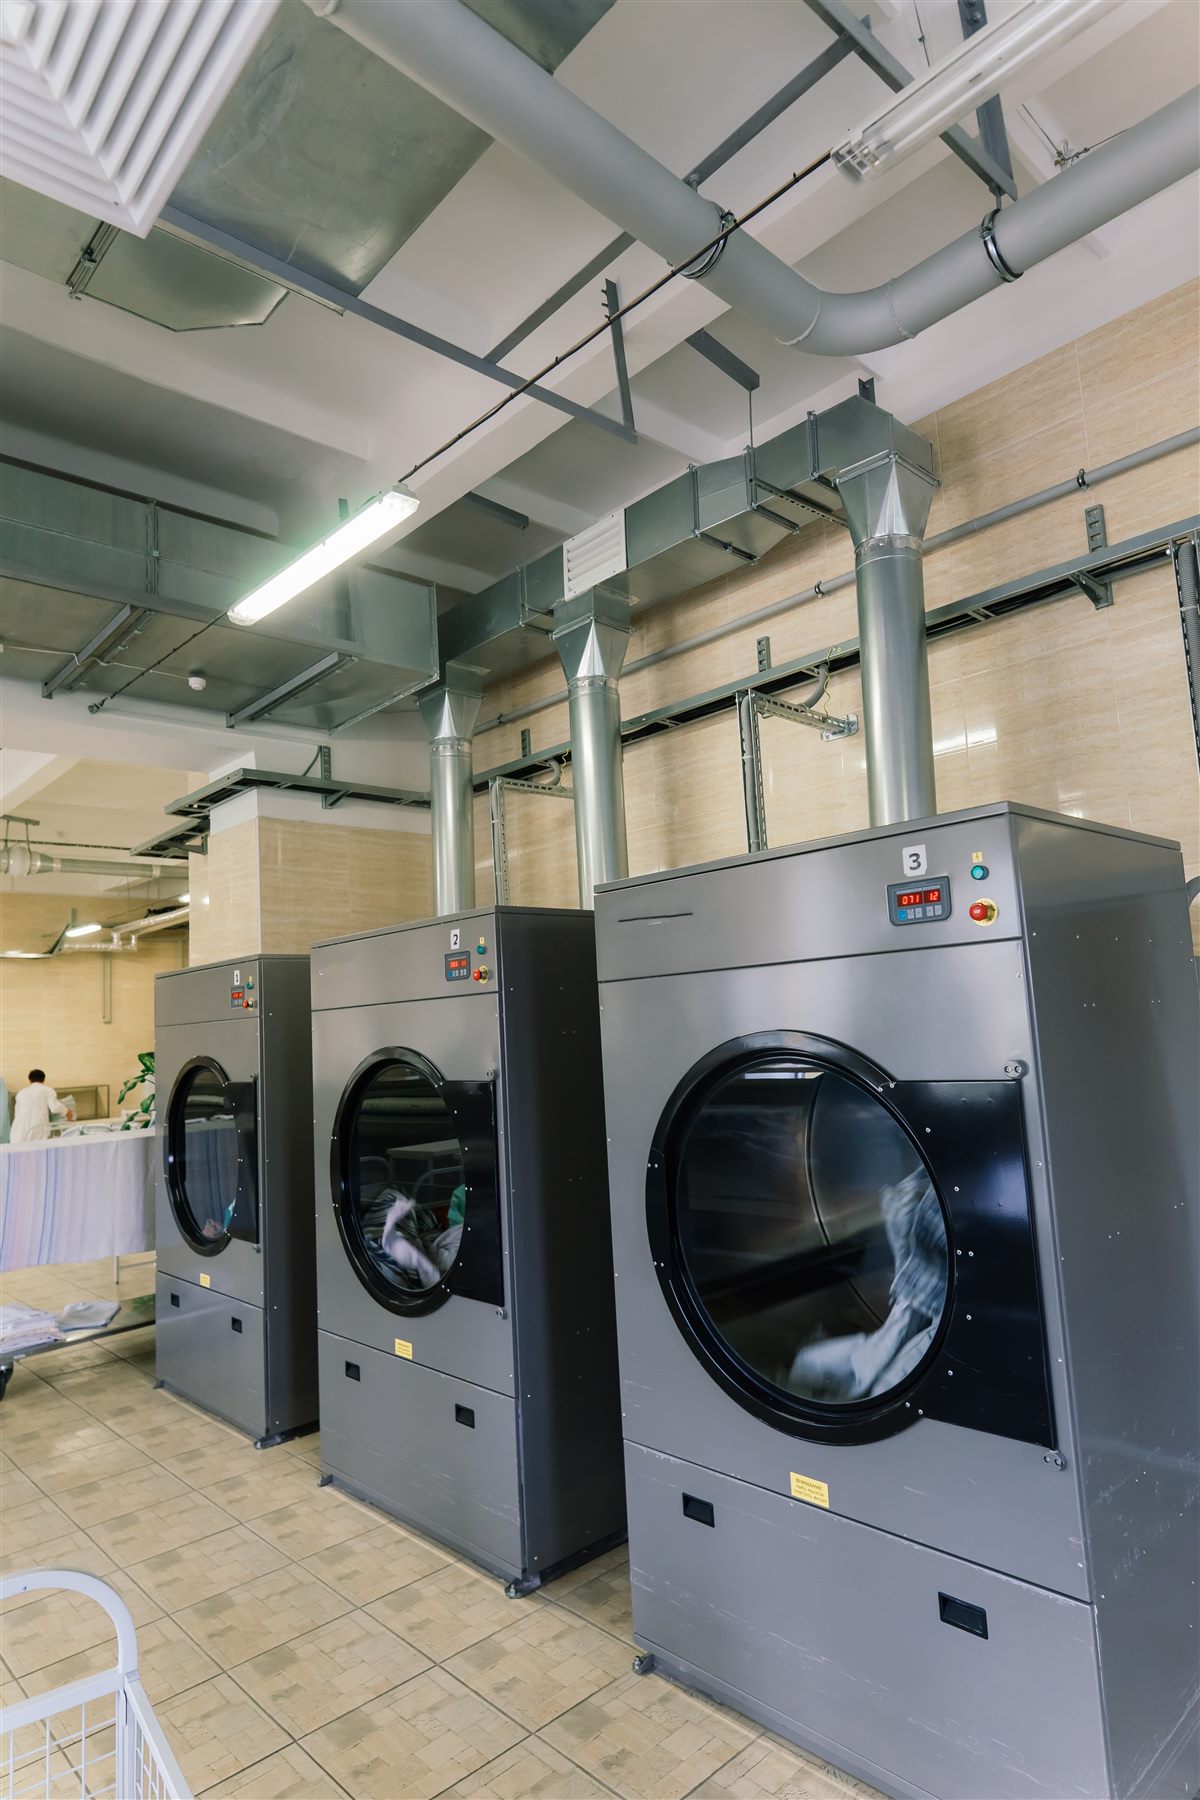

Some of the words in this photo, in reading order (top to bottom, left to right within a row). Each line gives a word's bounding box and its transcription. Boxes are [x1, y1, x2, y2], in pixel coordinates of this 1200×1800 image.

[908, 853, 921, 870] 3
[902, 895, 919, 905] 071
[929, 892, 939, 901] 12
[453, 934, 459, 945] 2
